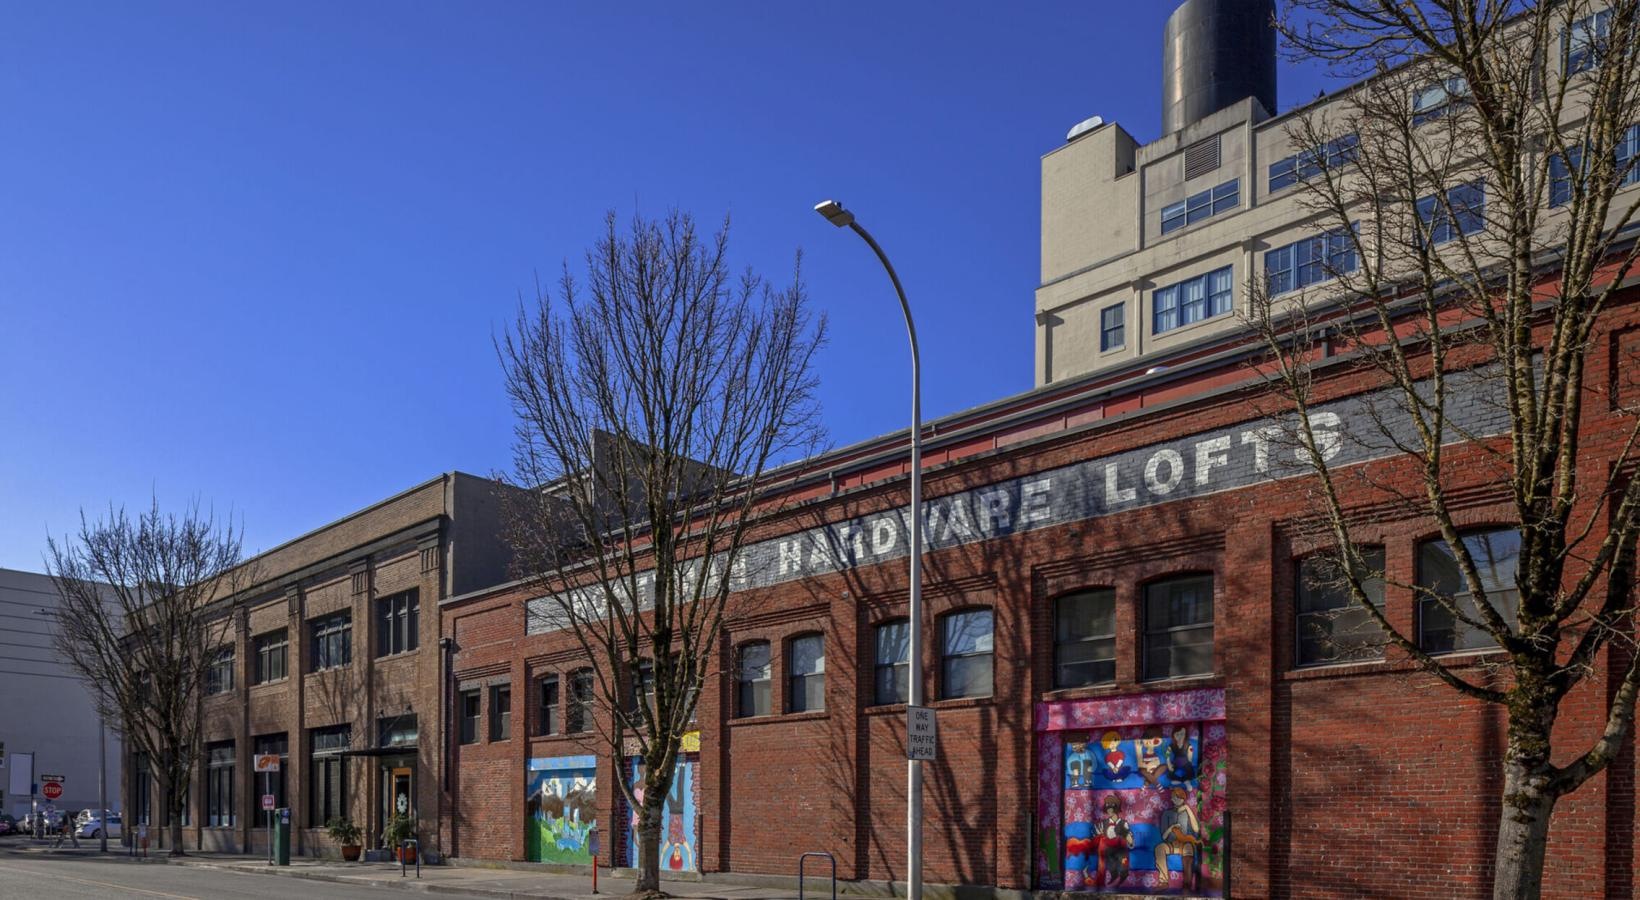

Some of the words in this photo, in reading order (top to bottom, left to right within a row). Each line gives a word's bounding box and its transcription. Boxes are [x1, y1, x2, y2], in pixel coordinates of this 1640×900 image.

[779, 479, 1050, 576] HARDWARE
[1105, 412, 1342, 505] LOFTS
[915, 711, 928, 721] ONE
[915, 723, 928, 731] WAY
[910, 734, 935, 744] TRAFFIC
[912, 746, 933, 756] AHEAD
[44, 786, 61, 794] STOP
